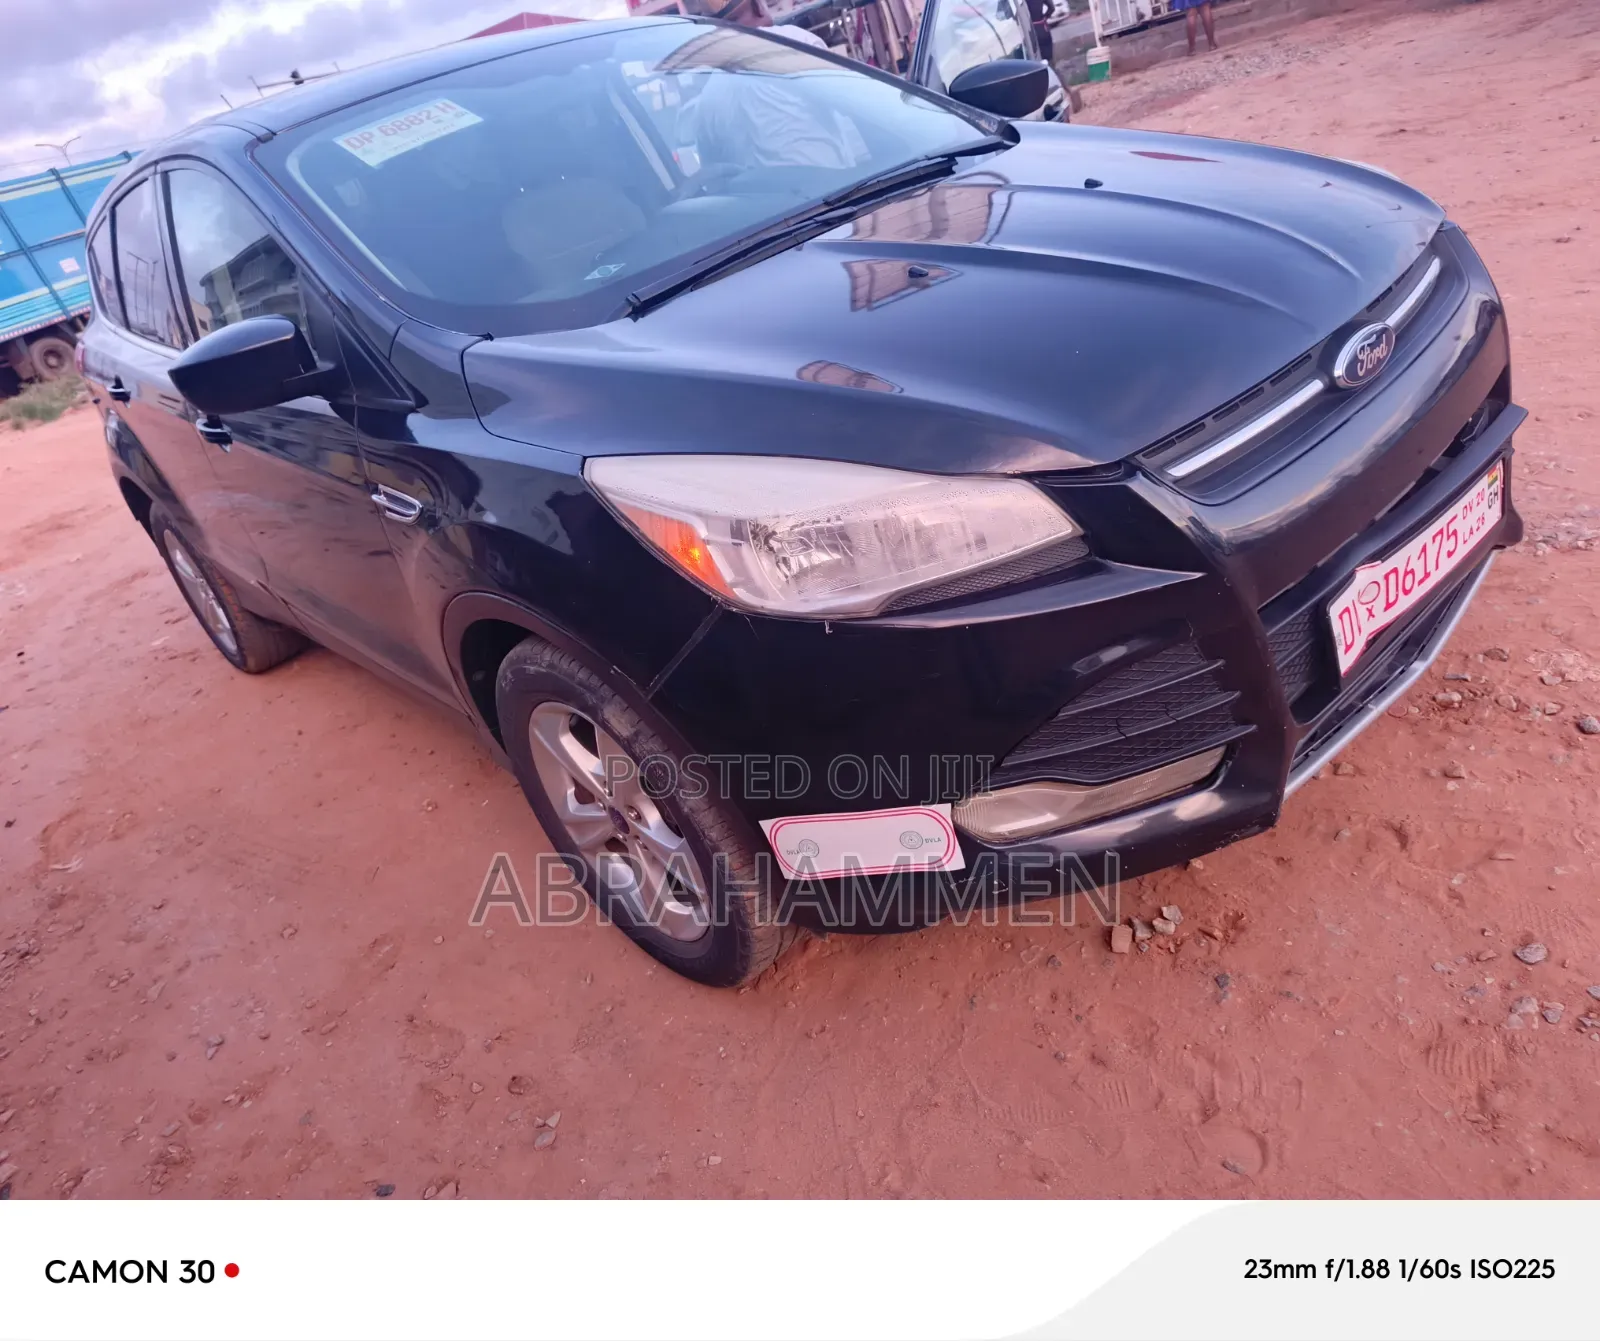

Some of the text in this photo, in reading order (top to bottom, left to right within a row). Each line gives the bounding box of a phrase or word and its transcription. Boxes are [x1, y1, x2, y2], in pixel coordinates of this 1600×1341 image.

[343, 130, 375, 150] DP
[378, 109, 439, 137] 6882
[1357, 334, 1389, 377] Ford
[1487, 484, 1499, 510] GH
